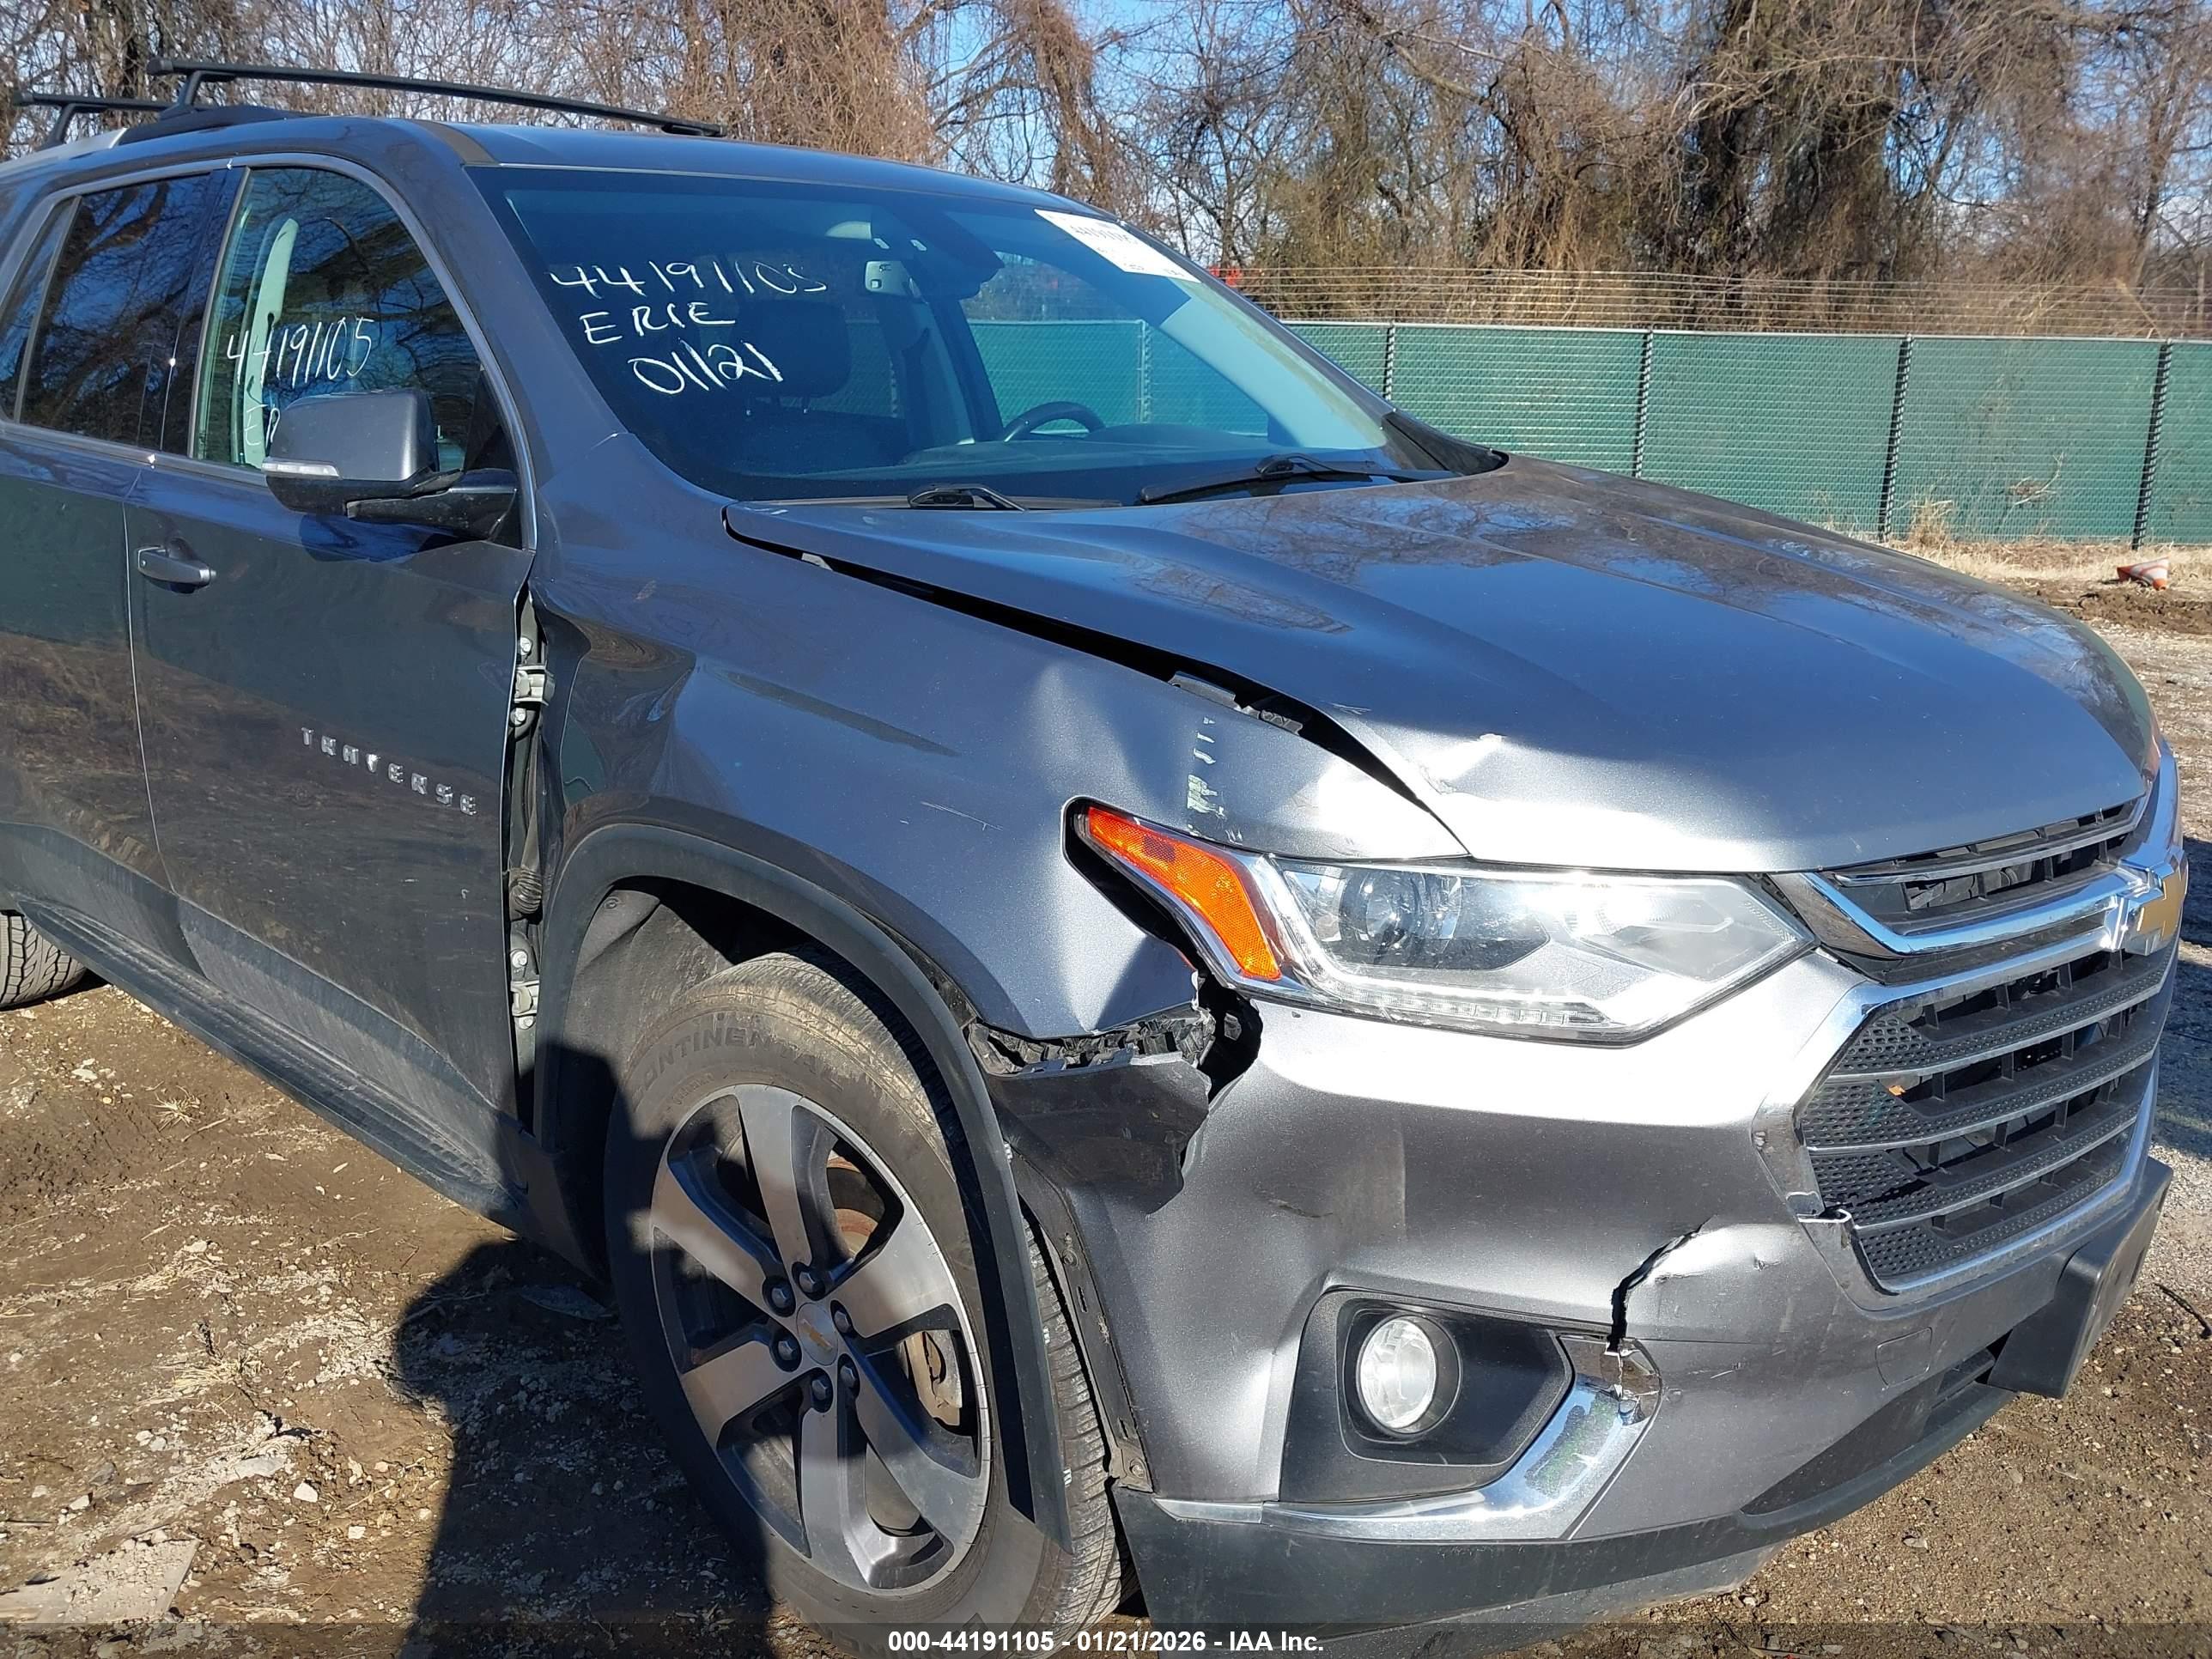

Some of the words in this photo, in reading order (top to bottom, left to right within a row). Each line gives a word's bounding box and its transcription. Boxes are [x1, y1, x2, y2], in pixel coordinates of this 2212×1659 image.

[548, 260, 827, 299] 44191105
[579, 301, 736, 344] ERIE
[301, 727, 477, 816] TRAVERSE
